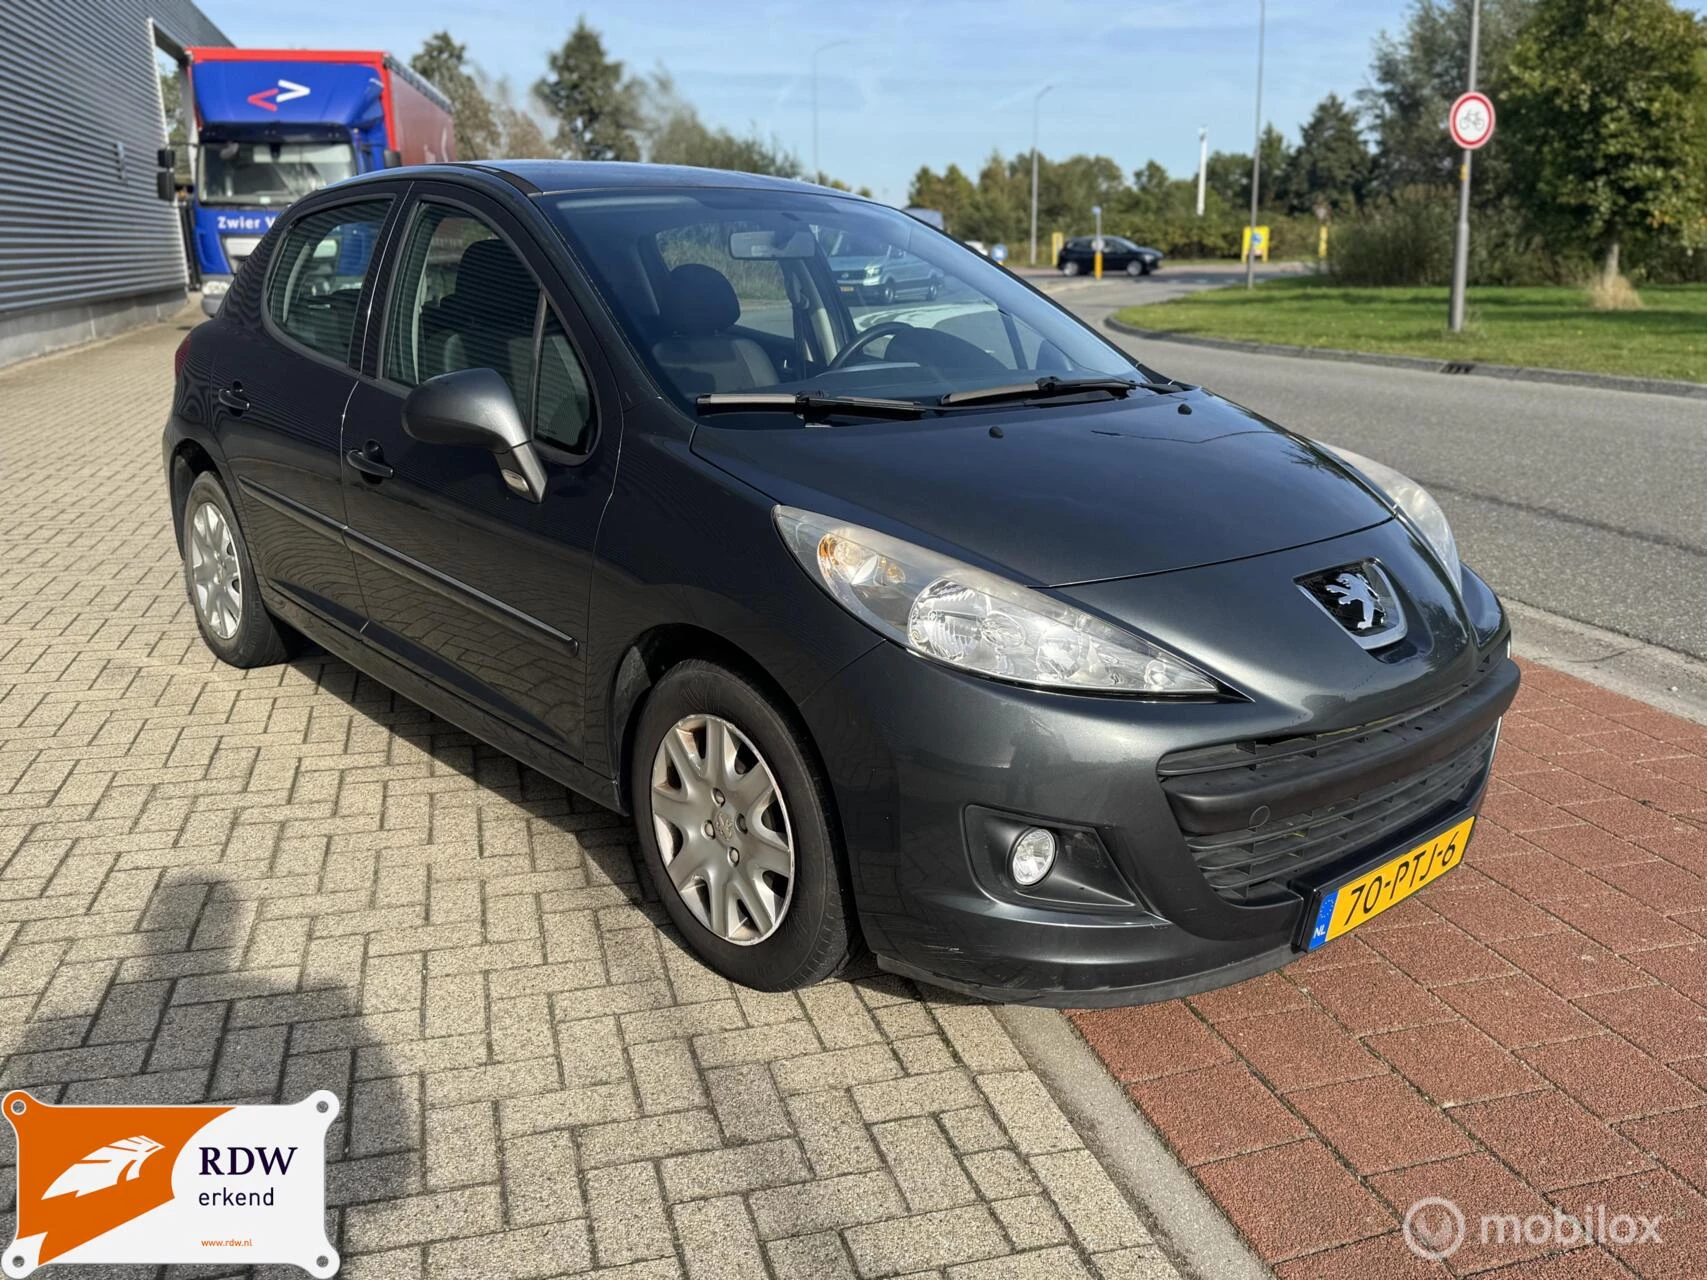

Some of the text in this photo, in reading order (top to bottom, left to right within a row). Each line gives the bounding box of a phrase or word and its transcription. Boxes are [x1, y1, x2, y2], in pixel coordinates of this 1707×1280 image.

[217, 216, 260, 229] Zwier
[1344, 831, 1459, 926] 70-PTJ-6
[1313, 925, 1326, 939] NL
